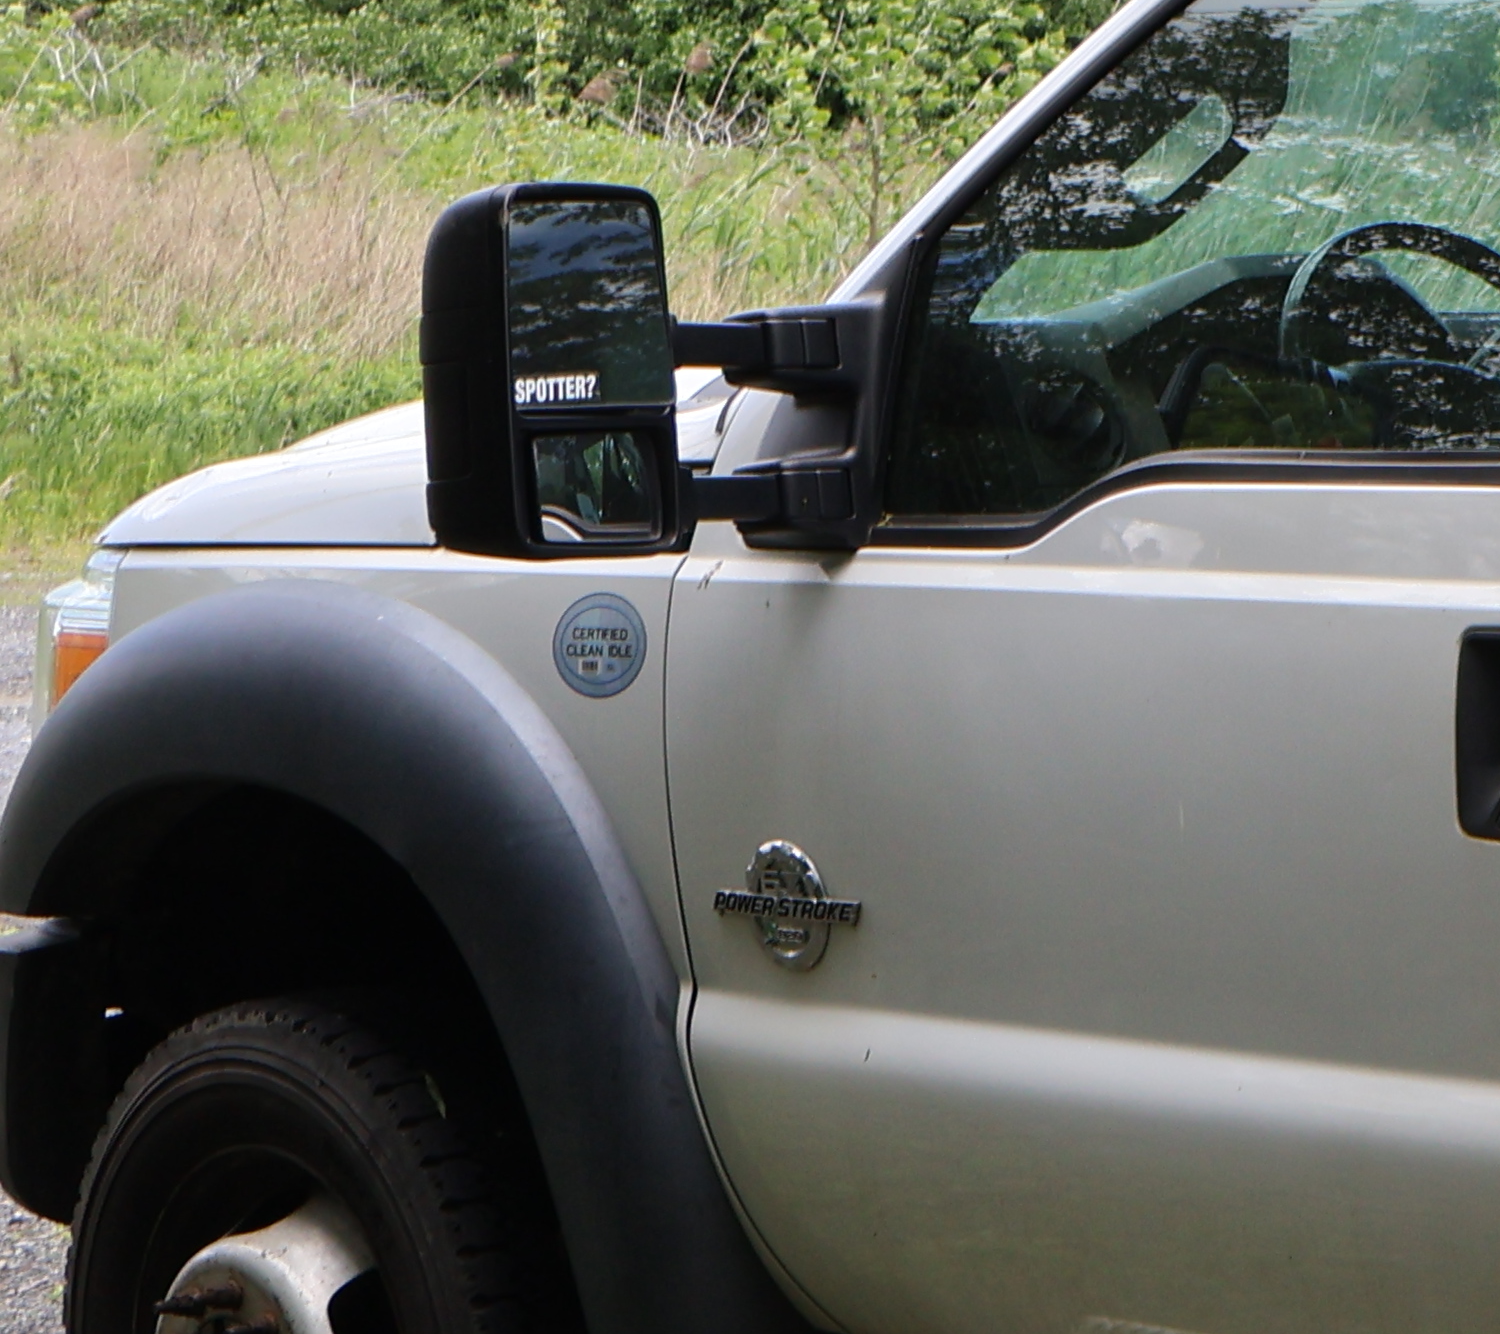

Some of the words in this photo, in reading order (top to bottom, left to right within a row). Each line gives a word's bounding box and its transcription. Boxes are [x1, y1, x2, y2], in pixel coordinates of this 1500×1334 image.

[515, 375, 597, 404] SPOTTER?
[572, 627, 628, 641] CERTIFIED
[566, 644, 603, 657] CLEAN
[608, 645, 633, 659] IDLE
[714, 890, 774, 916] POWER
[778, 897, 850, 922] STROKE
